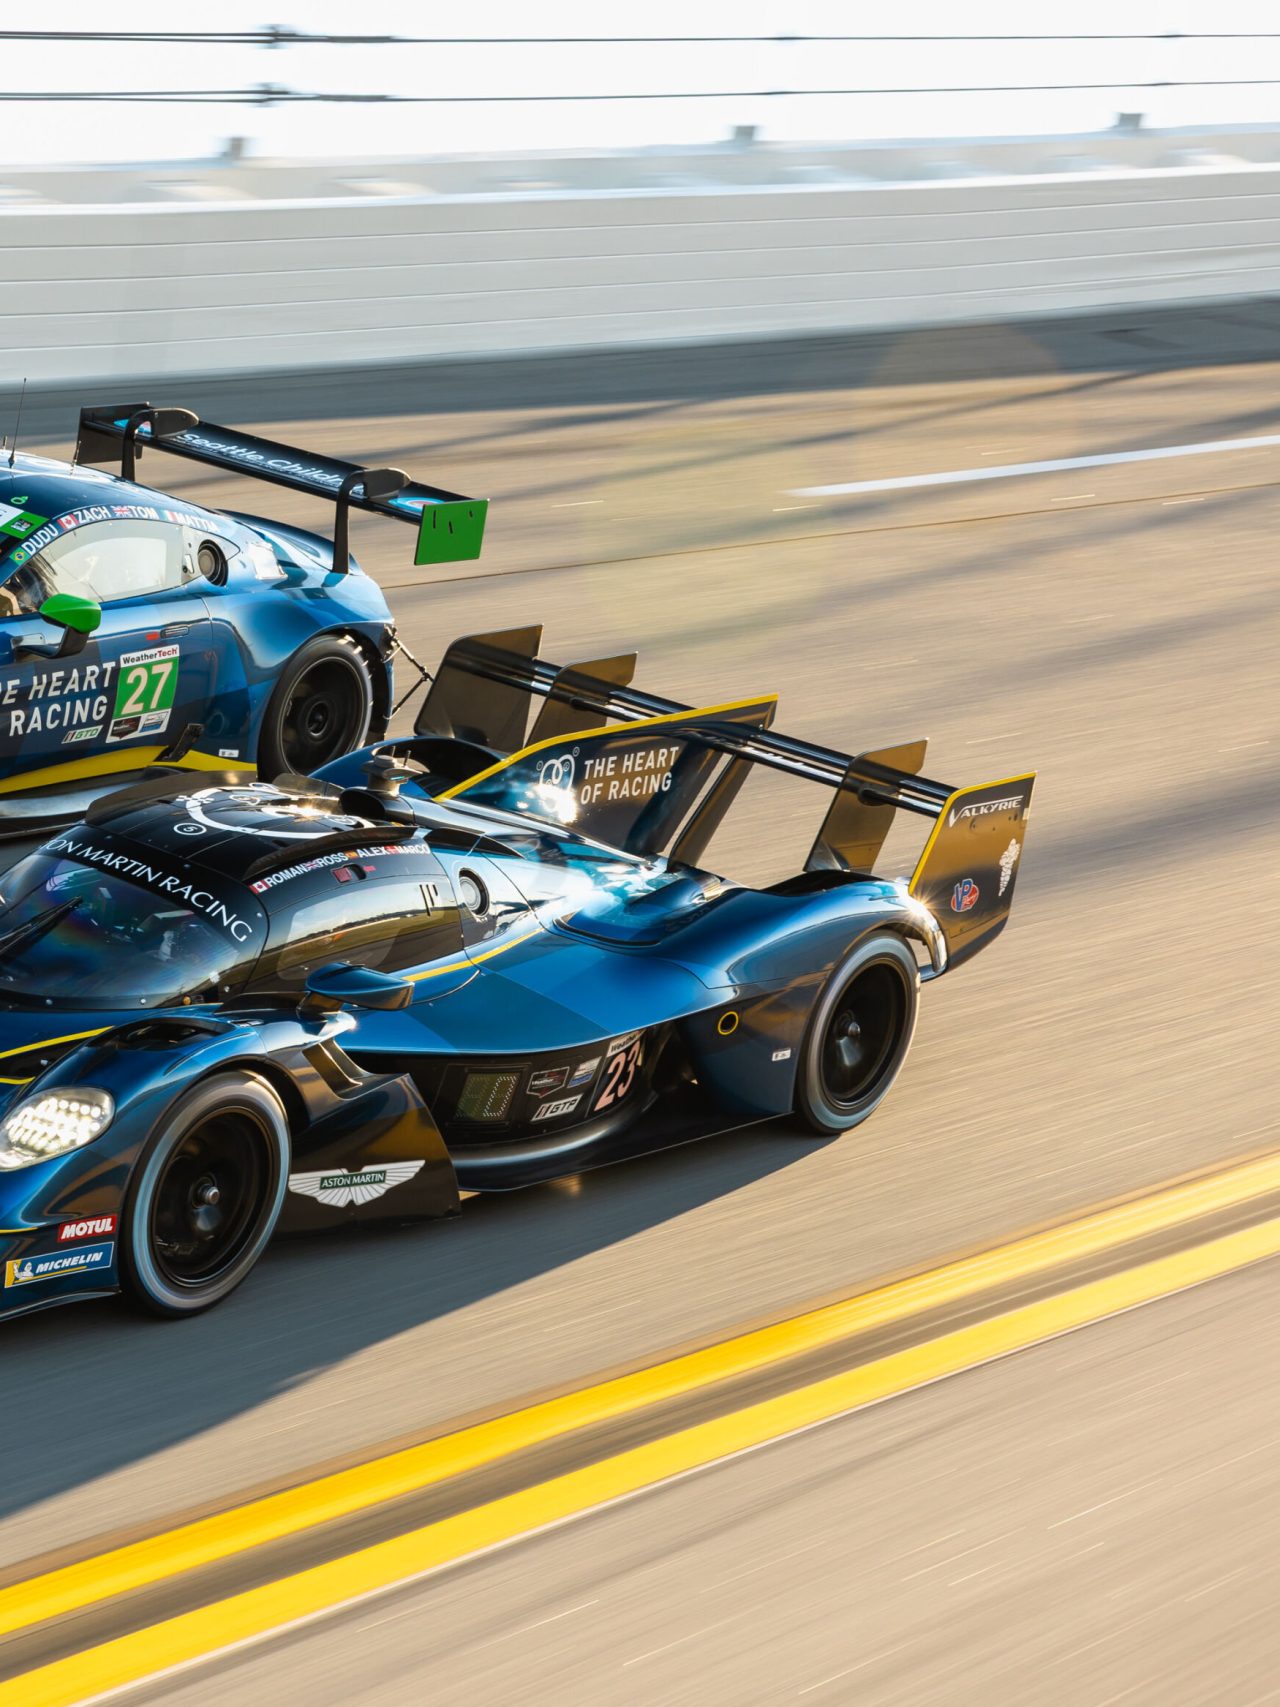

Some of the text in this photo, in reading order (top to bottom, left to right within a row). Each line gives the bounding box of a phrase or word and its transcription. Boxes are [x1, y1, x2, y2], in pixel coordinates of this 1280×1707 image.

[176, 434, 264, 461] Seattle
[21, 523, 59, 556] DUDU
[75, 506, 111, 525] ZACH
[129, 506, 160, 520] TOM
[122, 647, 178, 664] WeatherTech
[28, 661, 116, 701] HEART
[121, 662, 173, 715] 27
[9, 695, 108, 737] RACING
[75, 728, 99, 740] GTD
[584, 746, 680, 780] THE HEART
[580, 771, 672, 805] OF RACING
[949, 795, 1024, 828] VALKYRIE
[265, 864, 309, 888] ROMAN
[318, 852, 349, 868] ROSS
[356, 846, 387, 858] ALEX
[76, 846, 164, 883] MARTIN
[158, 876, 253, 942] RACING
[593, 1039, 641, 1112] 23
[549, 1099, 578, 1114] GTP
[321, 1172, 385, 1188] ASTON MARTIN
[61, 1217, 113, 1240] MOTUL
[35, 1251, 104, 1274] MICHELIN
